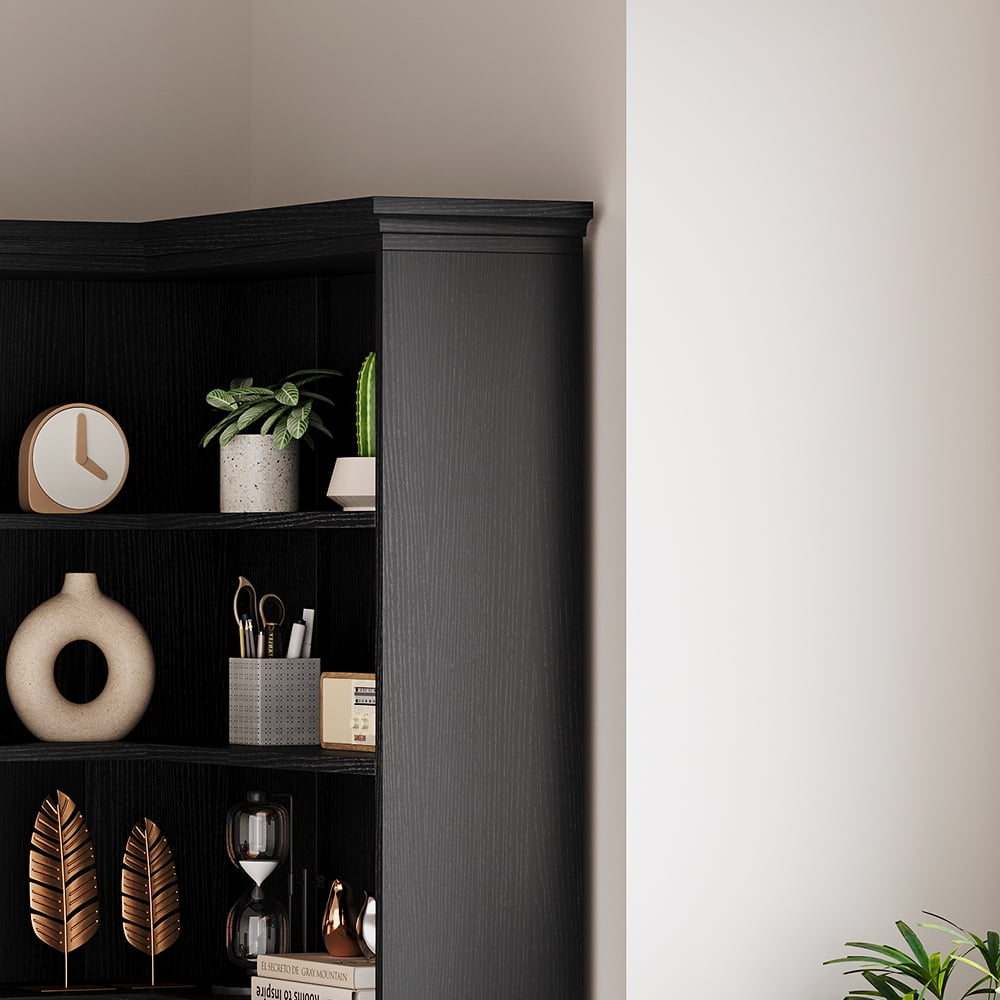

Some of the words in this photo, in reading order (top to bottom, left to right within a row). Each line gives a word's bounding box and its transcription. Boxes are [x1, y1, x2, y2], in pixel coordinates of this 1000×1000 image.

[262, 962, 267, 970] EL
[268, 962, 291, 974] SECRETO
[292, 966, 299, 975] DE
[301, 967, 315, 977] GRAY
[316, 970, 347, 981] MOUNTAIN
